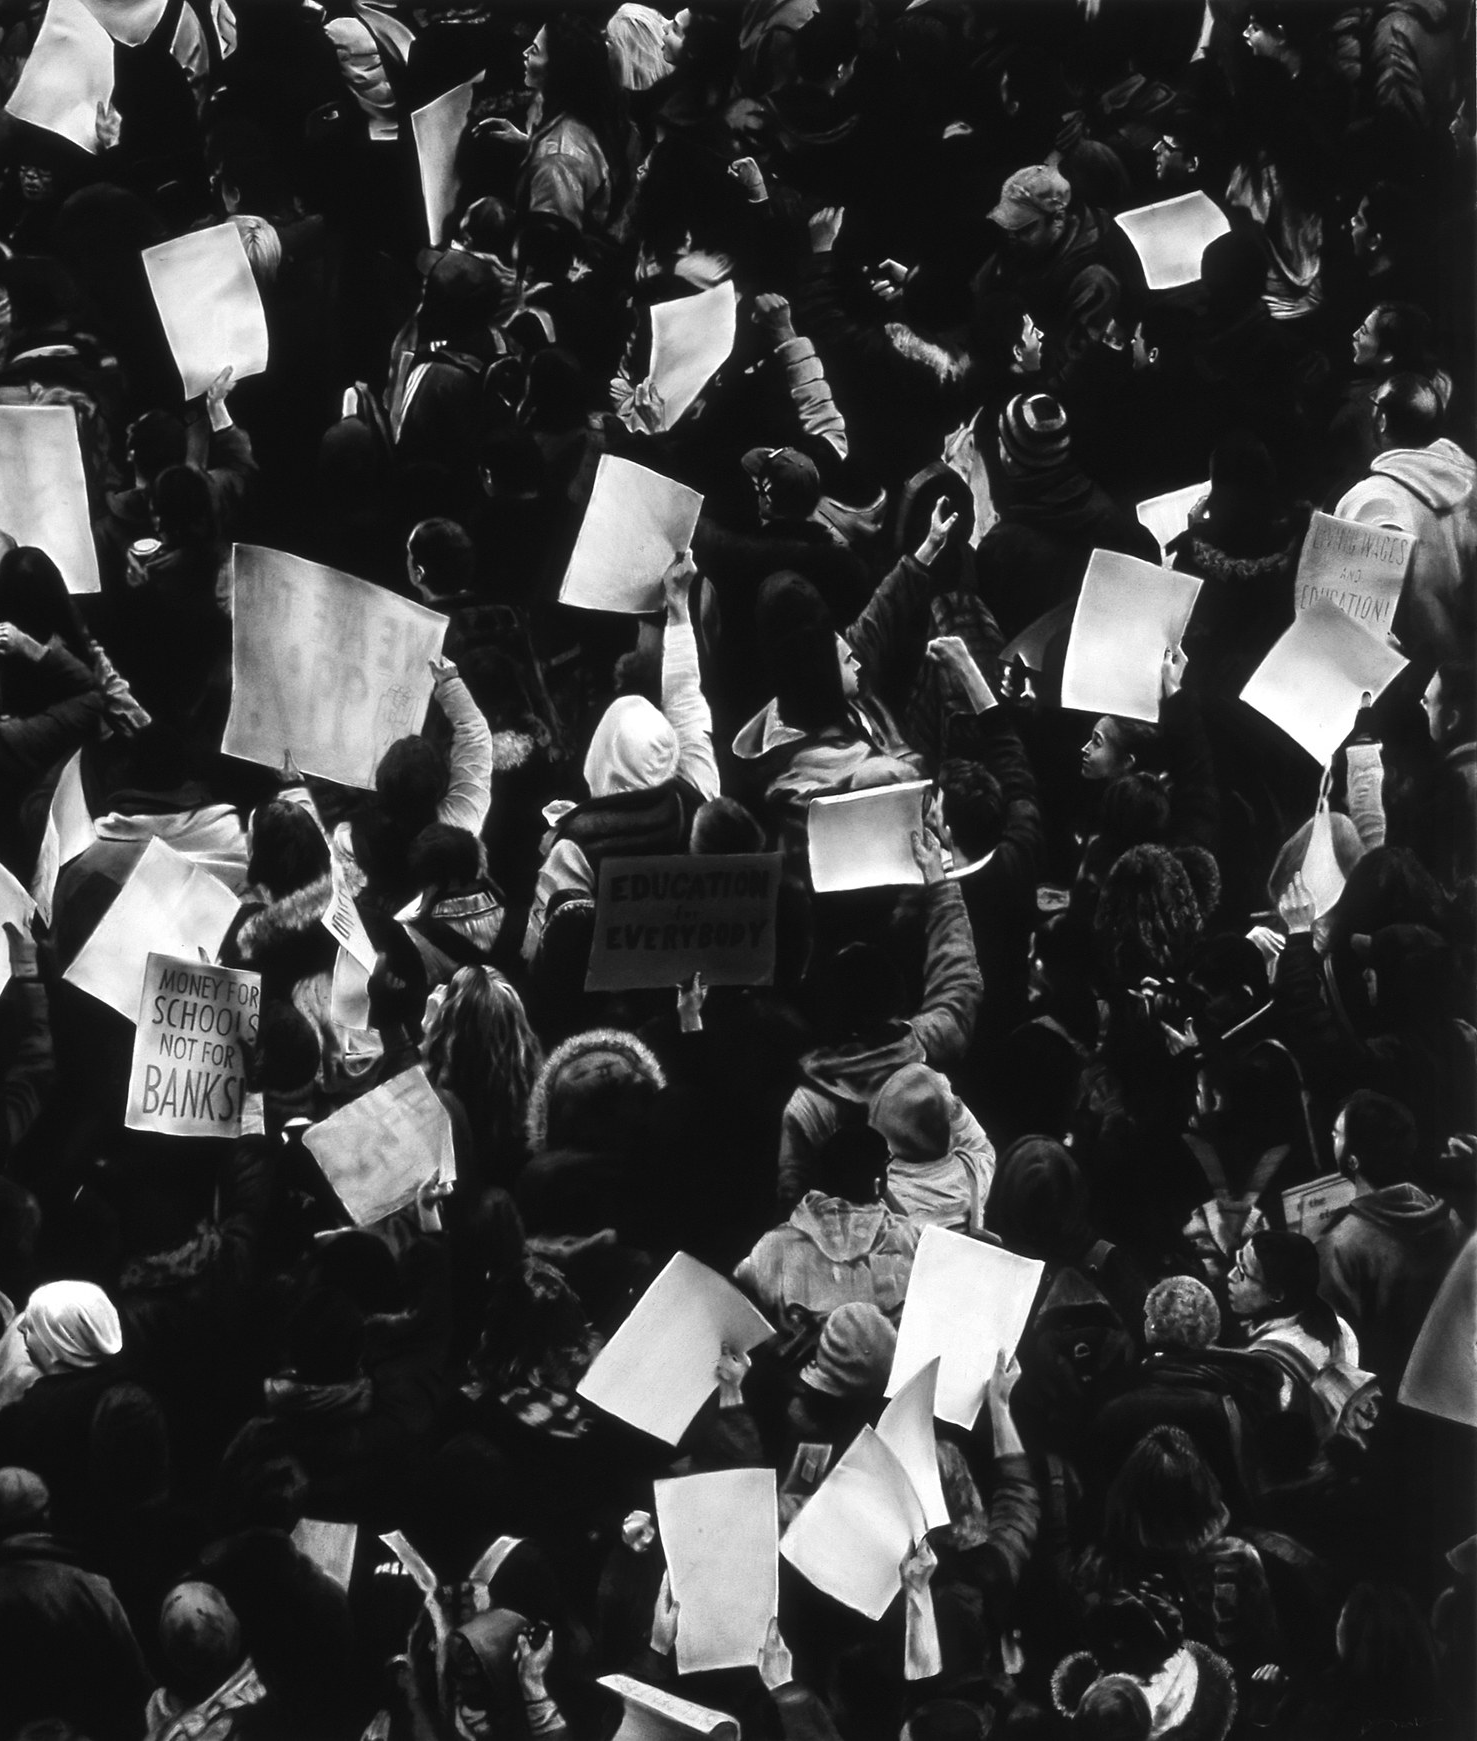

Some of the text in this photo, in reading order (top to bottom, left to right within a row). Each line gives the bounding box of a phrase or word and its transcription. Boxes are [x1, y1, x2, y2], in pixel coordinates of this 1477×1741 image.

[1339, 567, 1362, 584] AND
[611, 869, 770, 902] EDUCATION
[606, 919, 770, 950] EVERYBODY
[159, 968, 259, 1008] MONEY FOR
[159, 1033, 235, 1069] NOT FOR
[143, 1064, 245, 1123] BANKS!
